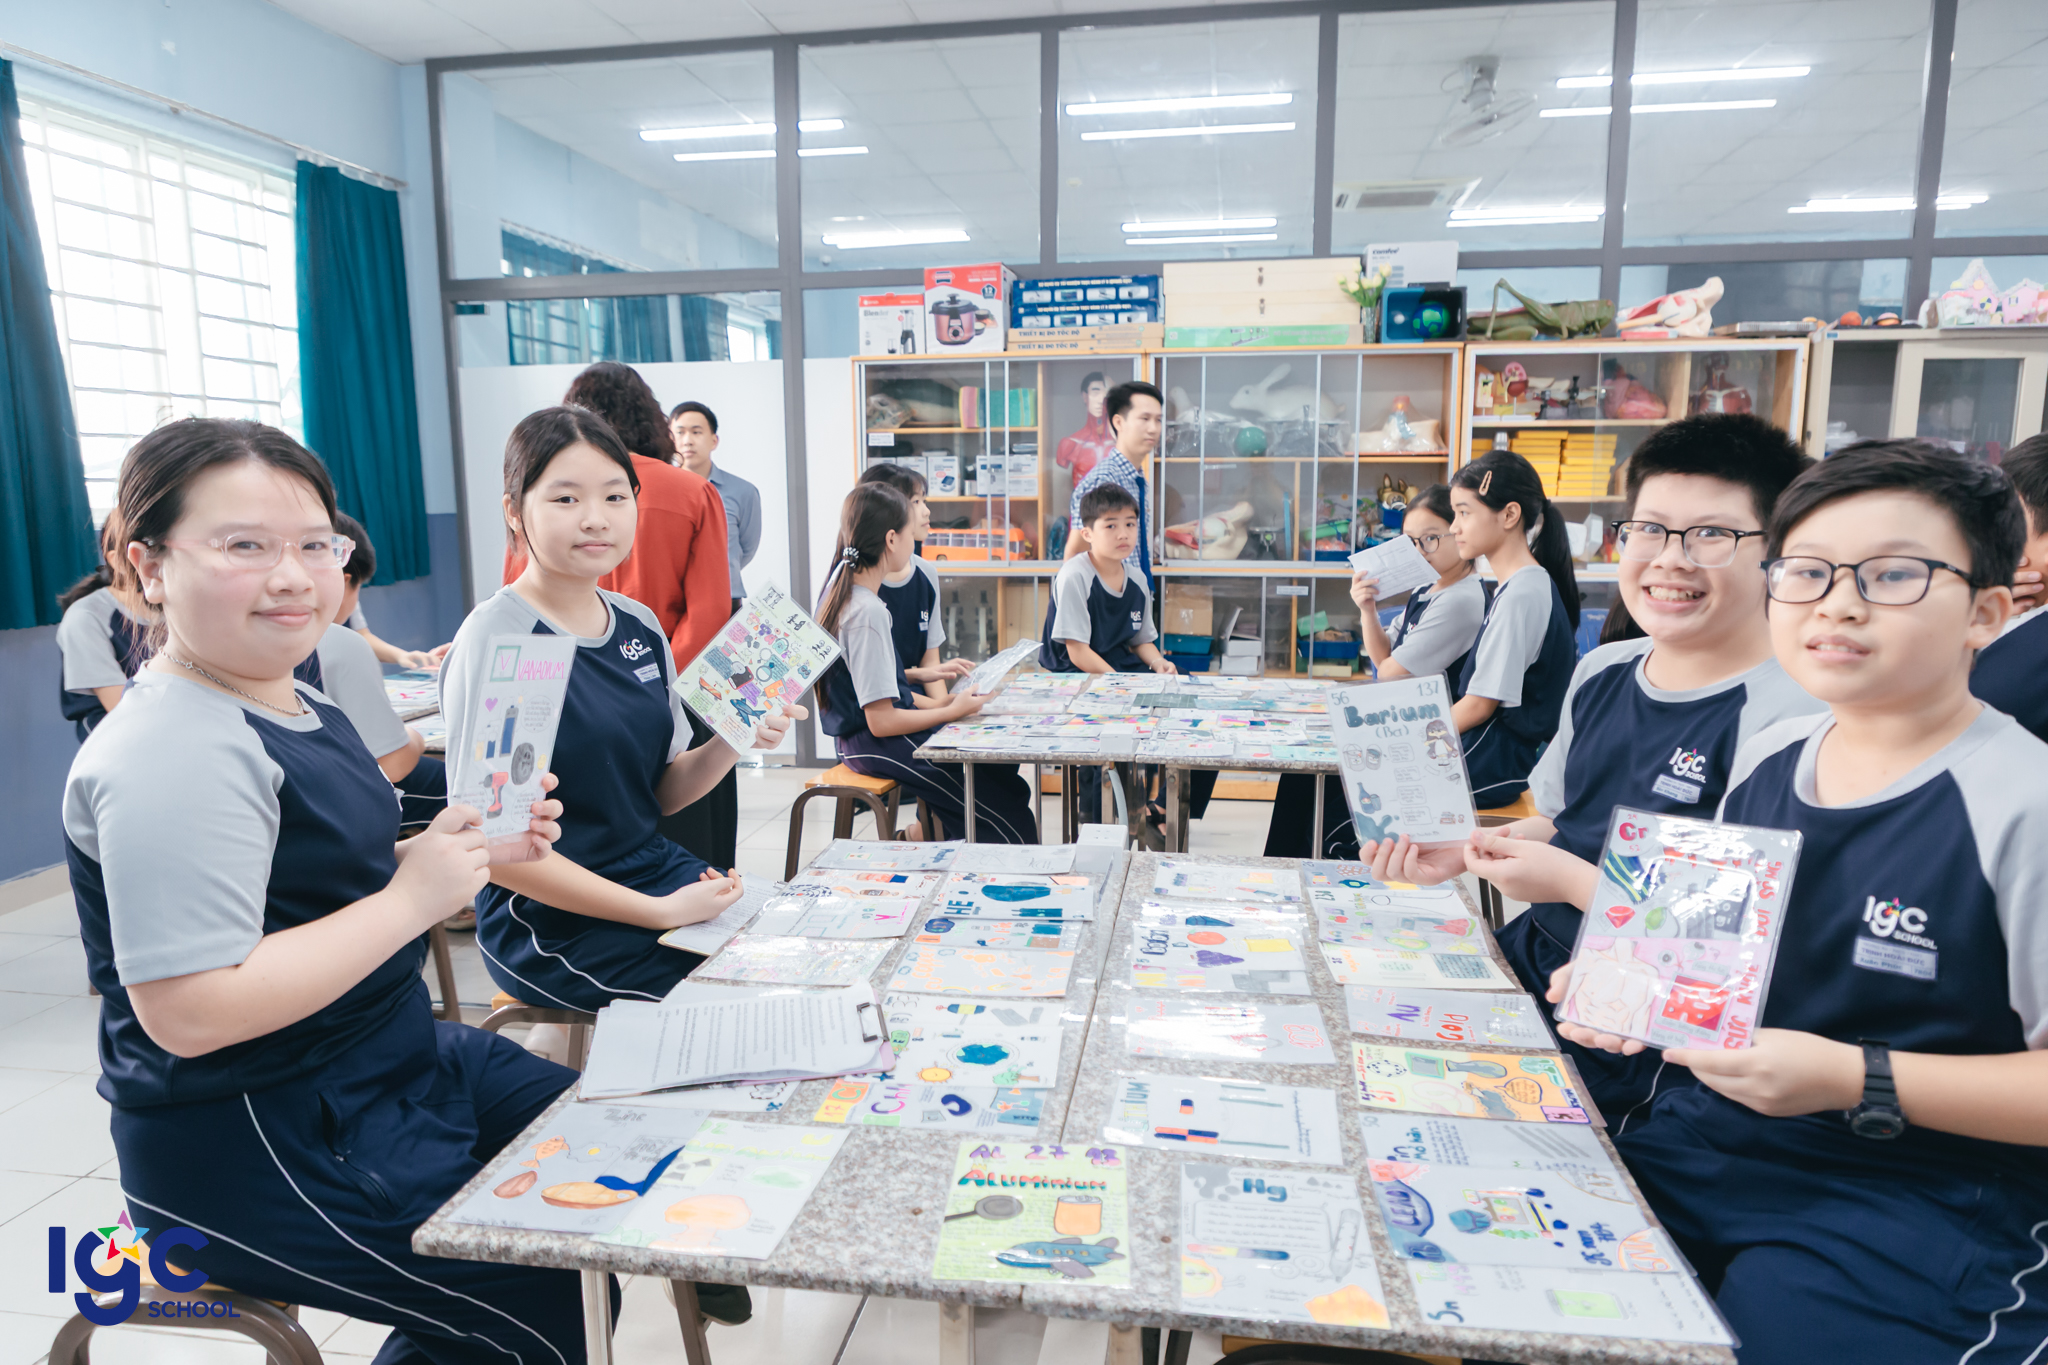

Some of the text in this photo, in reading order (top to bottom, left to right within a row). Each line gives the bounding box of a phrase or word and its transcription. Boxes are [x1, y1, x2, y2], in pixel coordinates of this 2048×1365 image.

[501, 654, 511, 671] V
[1415, 680, 1440, 697] 137
[1331, 691, 1350, 706] 56
[1343, 703, 1441, 728] Barium
[1375, 724, 1410, 739] (Ba)
[1619, 822, 1649, 841] Cr
[1892, 930, 1938, 950] SCHOOL
[1436, 1013, 1470, 1042] Gold
[604, 1108, 648, 1121] Zinc
[1024, 1144, 1069, 1160] 27
[1085, 1147, 1122, 1167] 13
[1243, 1178, 1288, 1203] Hg
[1426, 1300, 1465, 1324] Sn
